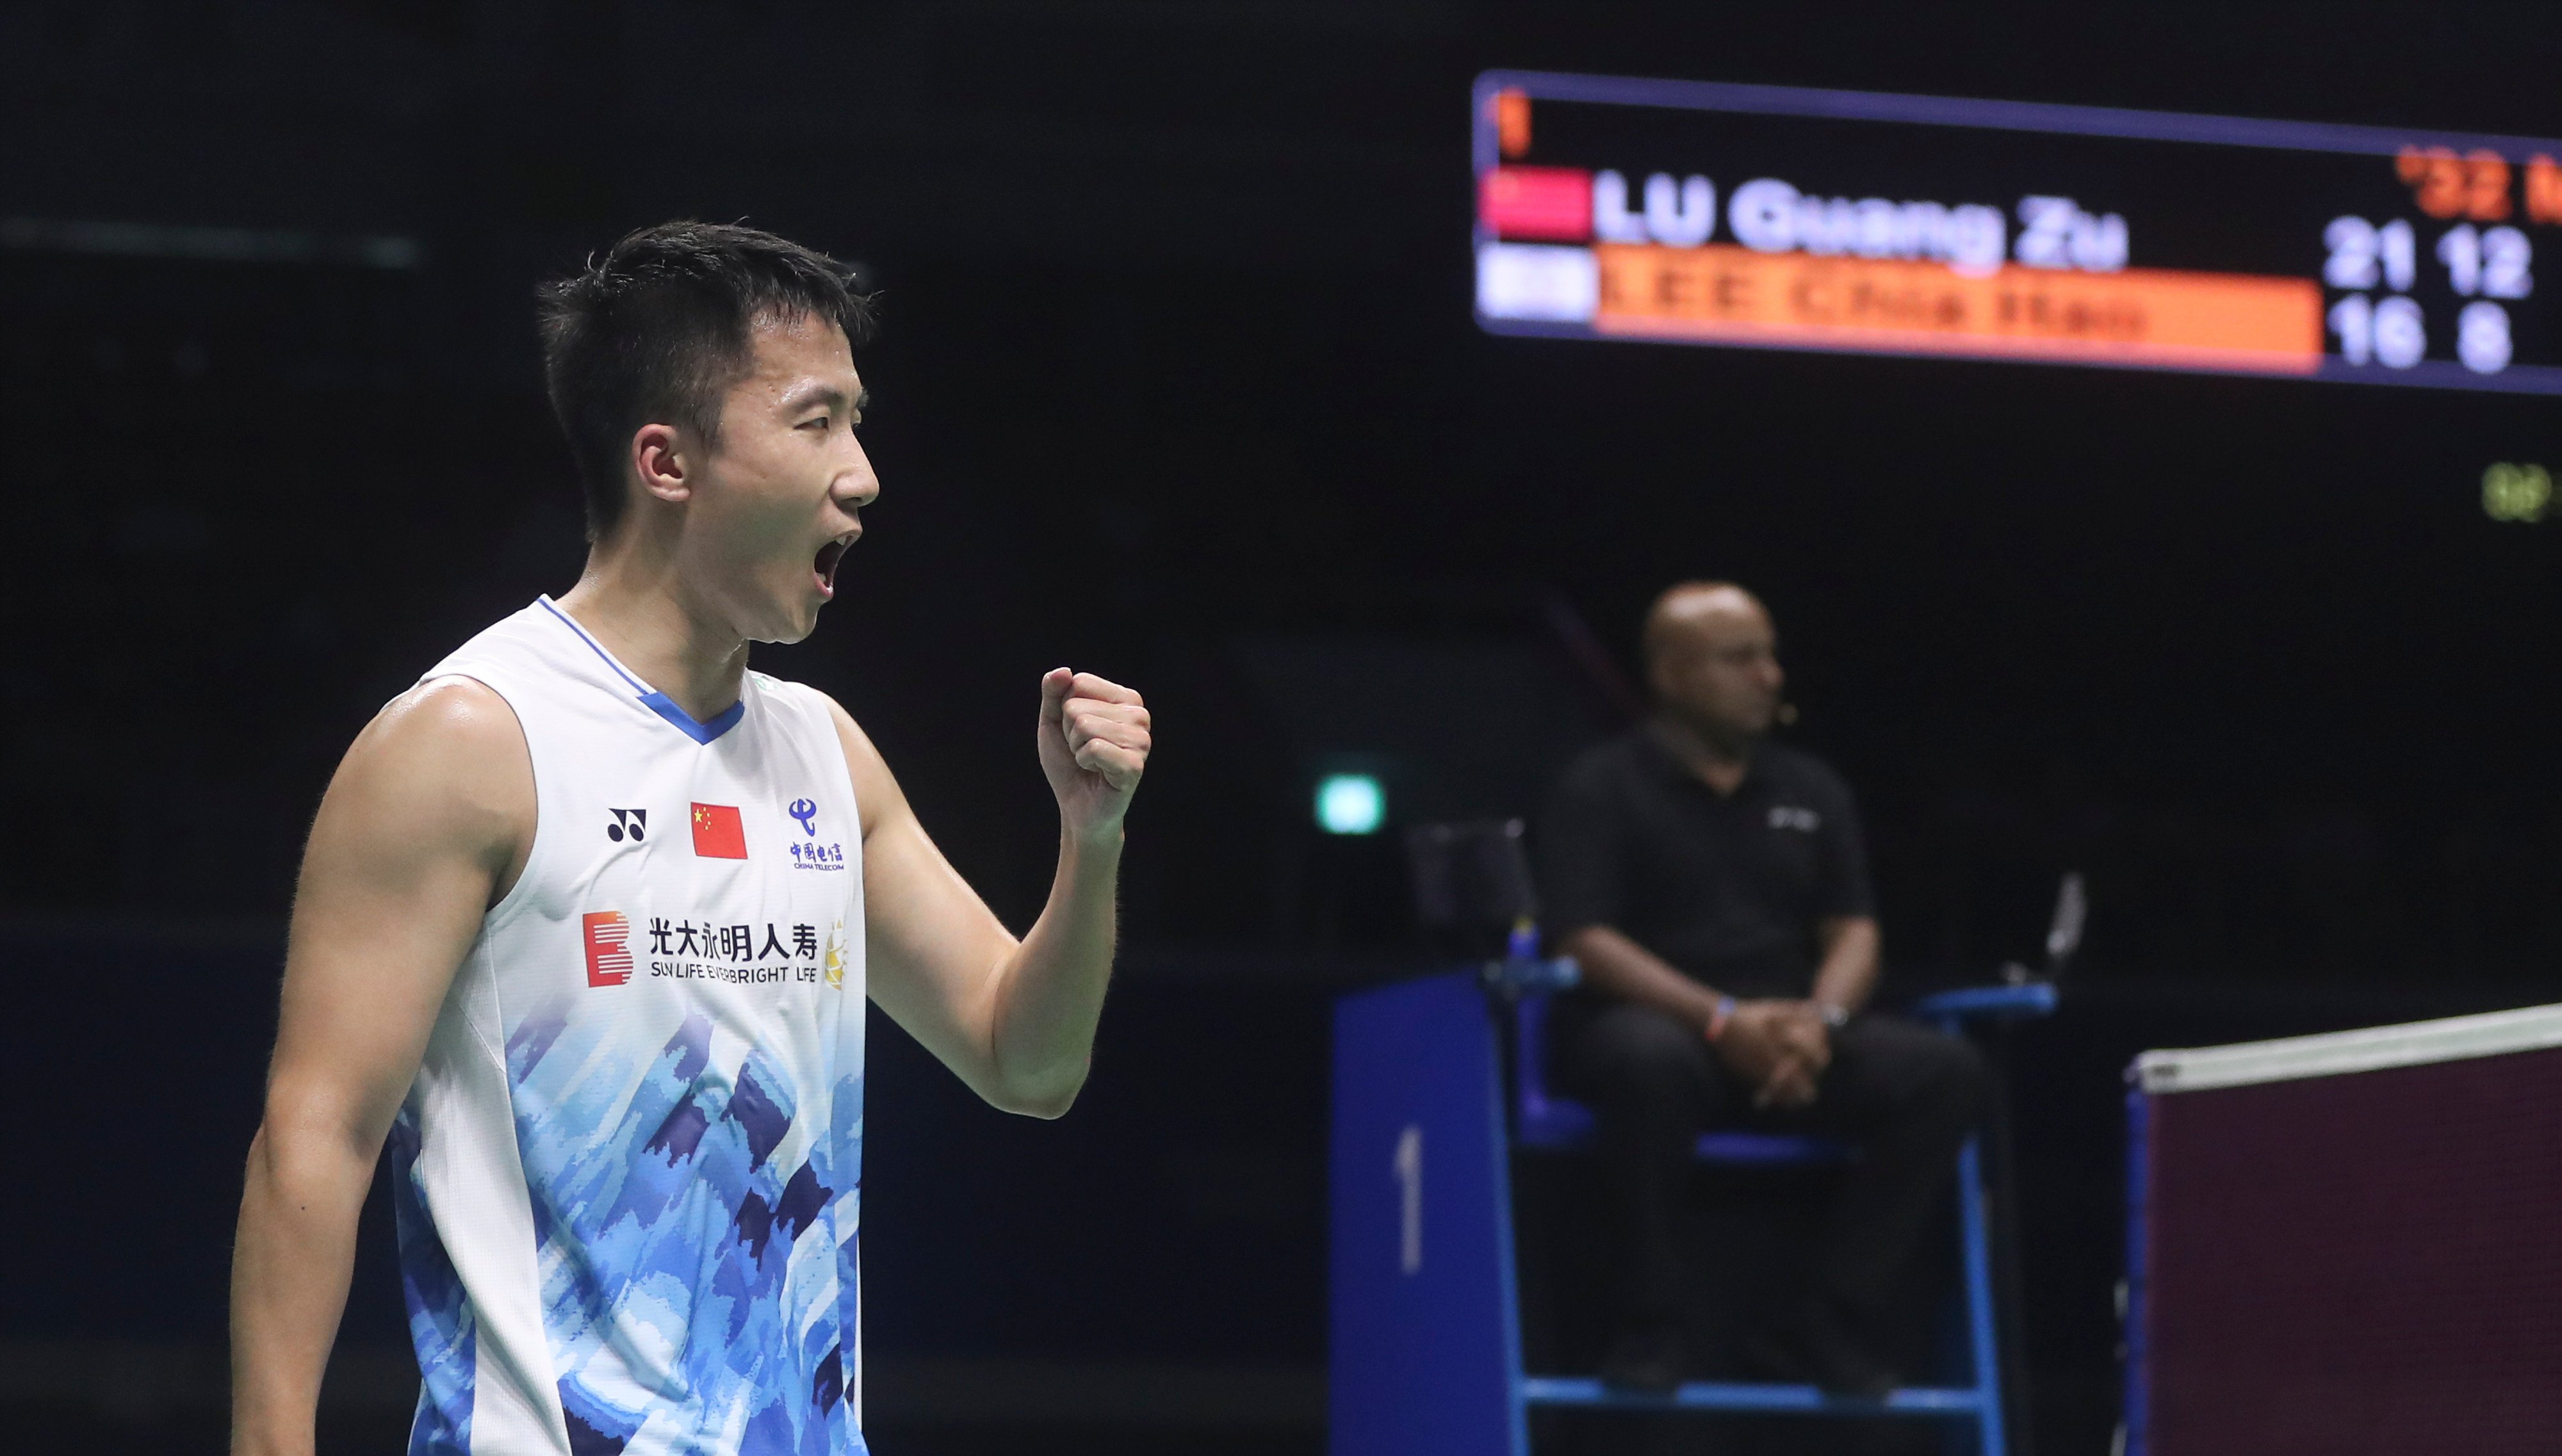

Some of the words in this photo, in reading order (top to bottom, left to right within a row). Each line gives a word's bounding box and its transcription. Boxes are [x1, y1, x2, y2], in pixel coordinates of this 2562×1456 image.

[1593, 169, 1717, 247] LU
[1727, 178, 2006, 279] Guang
[2014, 194, 2129, 273] Zu
[2323, 216, 2416, 292] 21
[2436, 223, 2533, 299] 12
[1599, 257, 1760, 319] LEE
[2328, 295, 2426, 369] 16
[2458, 301, 2513, 374] 8
[790, 841, 842, 863] 中国电信
[649, 918, 817, 962] 光大永明人寿
[651, 962, 673, 977] SUN
[676, 963, 705, 978] LIFE
[706, 965, 788, 983] EVERBRIGHT
[1392, 1124, 1423, 1275] 1
